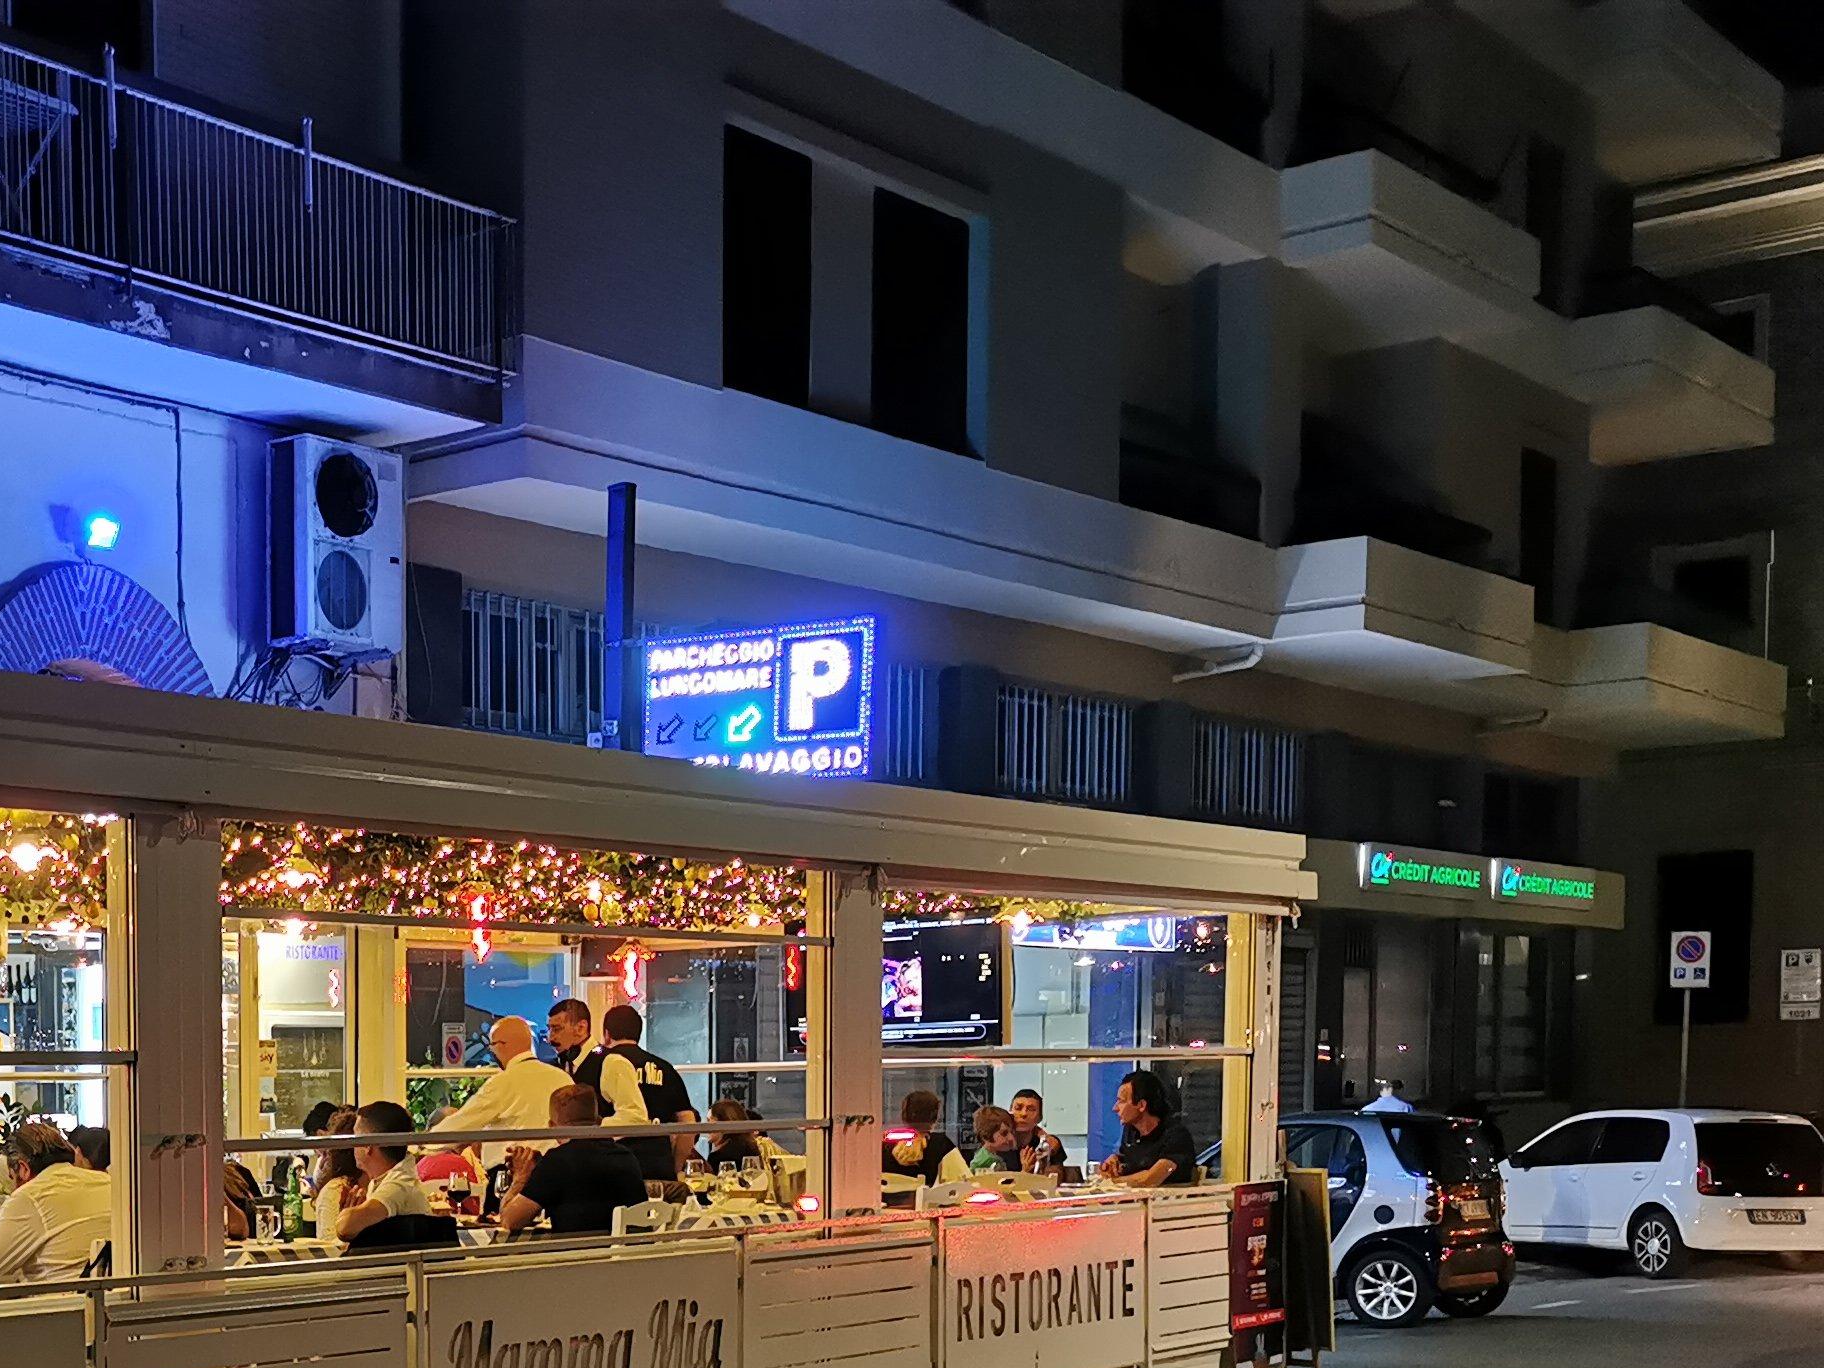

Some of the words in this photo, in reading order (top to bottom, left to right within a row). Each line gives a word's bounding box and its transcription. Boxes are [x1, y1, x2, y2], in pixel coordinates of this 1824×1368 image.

[649, 639, 775, 673] PARCHEGGIO
[650, 666, 773, 699] LUNGOMARE
[788, 638, 852, 731] P
[1391, 858, 1430, 883] CRÉDIT
[1430, 866, 1481, 889] AGRICOLE
[1519, 872, 1551, 893] CRÉDIT
[1551, 879, 1595, 899] AGRICOLE
[285, 945, 339, 960] RISTORANTE
[956, 1258, 1135, 1342] RISTORANTE
